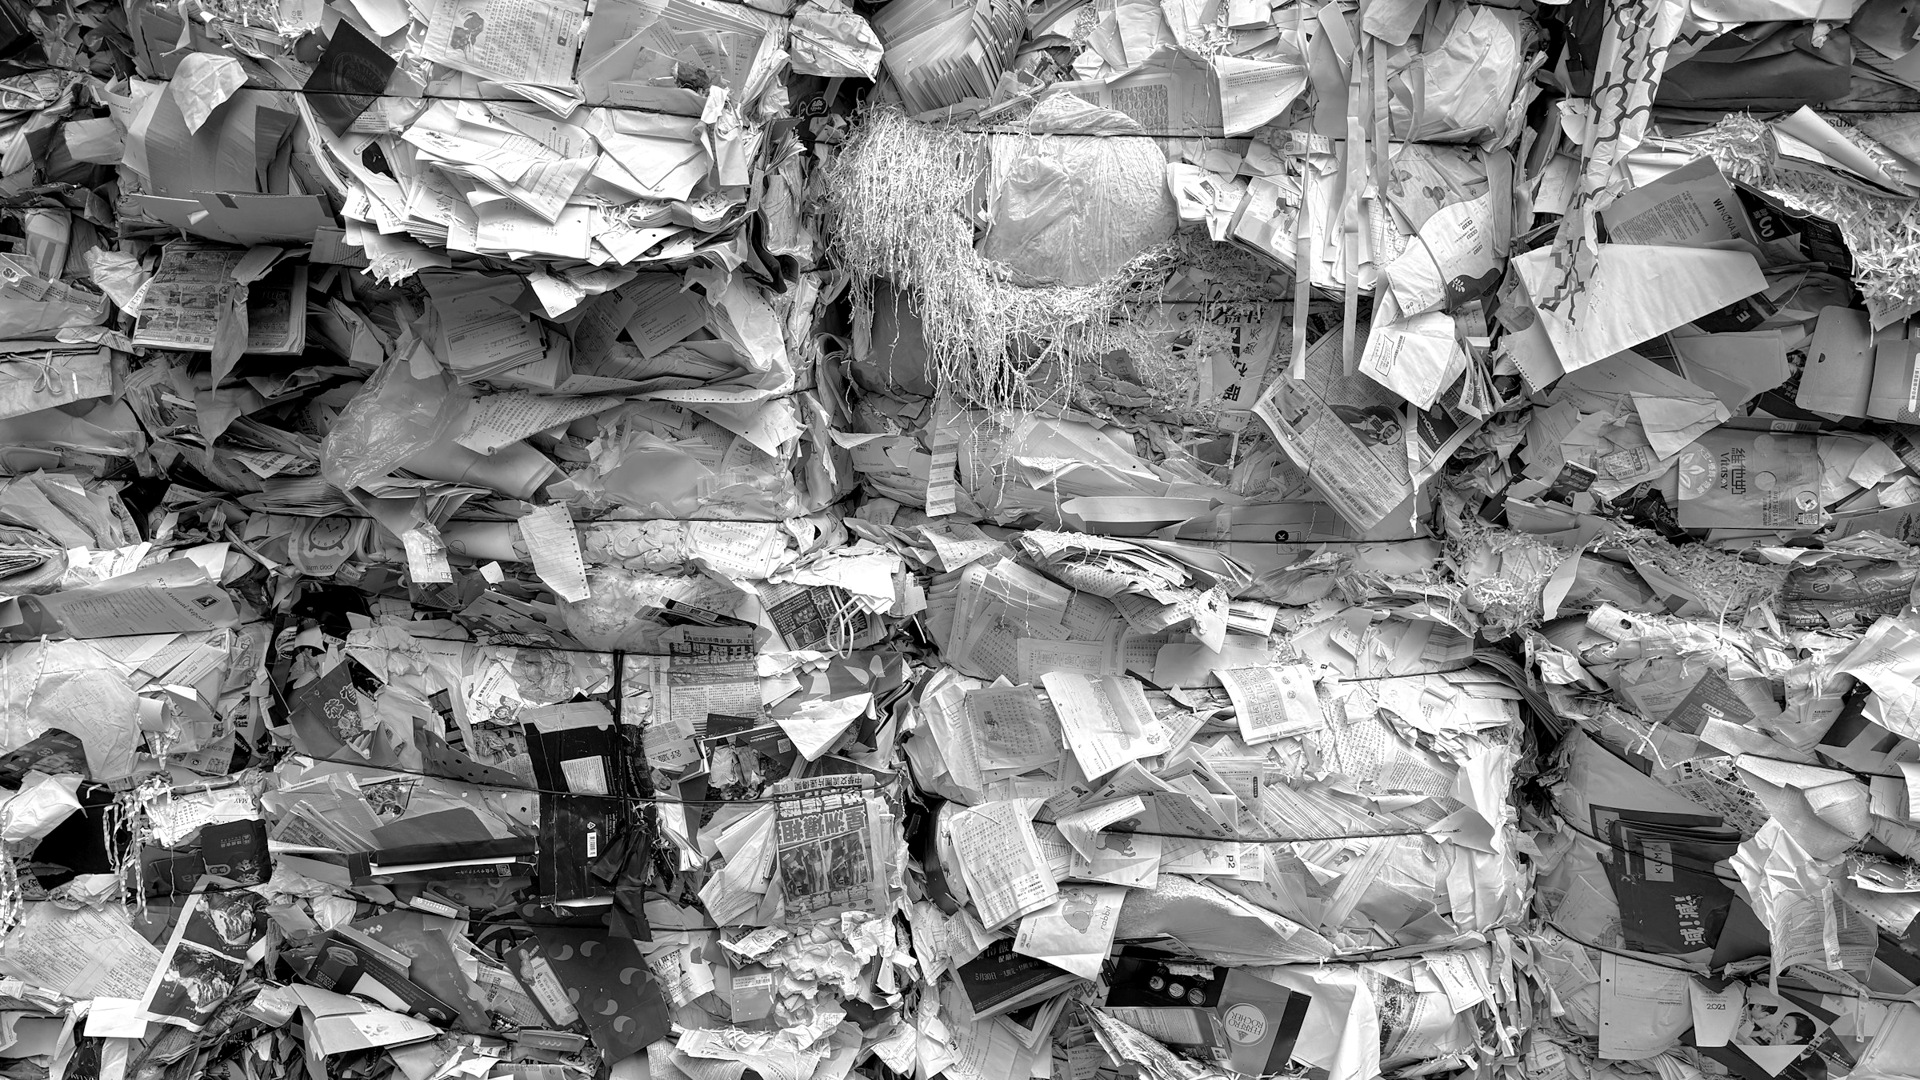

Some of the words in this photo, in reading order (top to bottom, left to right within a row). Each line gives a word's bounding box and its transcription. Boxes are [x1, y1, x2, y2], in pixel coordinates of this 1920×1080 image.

[1712, 198, 1736, 233] WINONA
[1721, 451, 1730, 490] Vitasoy
[1731, 447, 1746, 494] 維他奶
[233, 797, 250, 805] MAY
[1226, 854, 1236, 869] p2
[1101, 905, 1112, 930] rabbit
[1706, 1003, 1727, 1011] 2021
[1228, 1018, 1262, 1036] FERRERO
[1231, 1011, 1264, 1029] ROCHER
